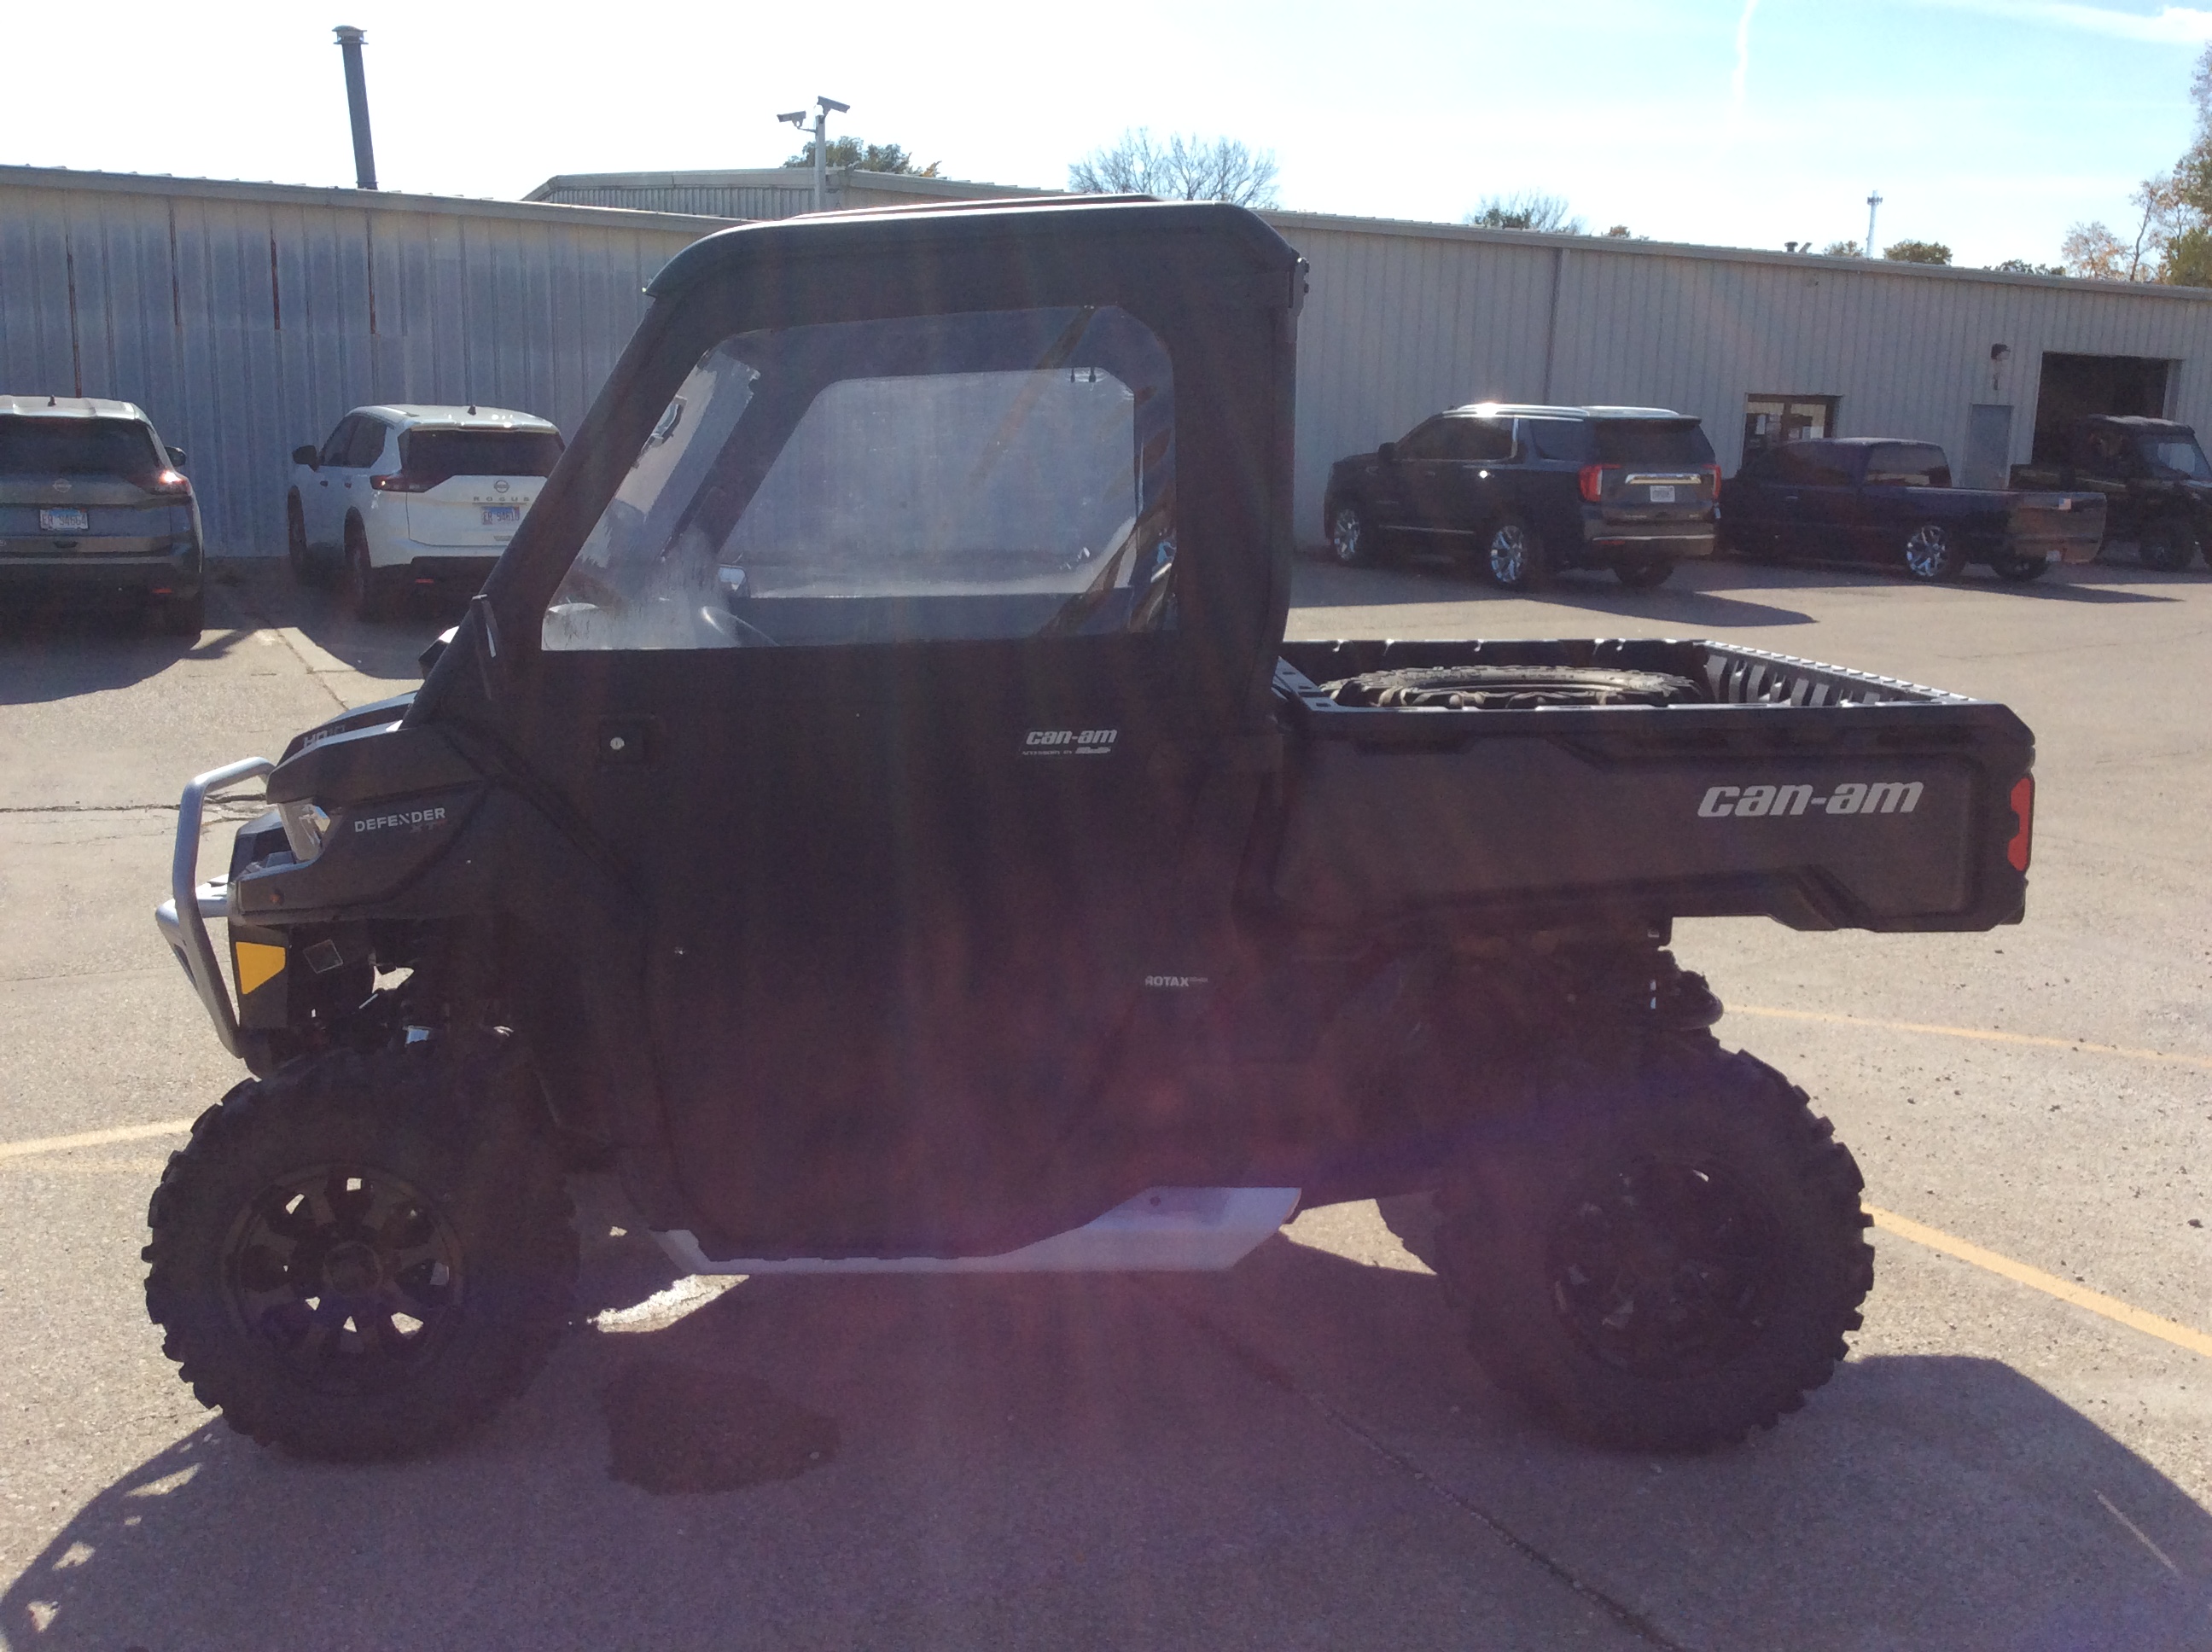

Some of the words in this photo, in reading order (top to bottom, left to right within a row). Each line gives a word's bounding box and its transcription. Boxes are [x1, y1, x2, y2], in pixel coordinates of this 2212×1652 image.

[1026, 729, 1118, 745] can-am
[1697, 781, 1924, 817] can-am
[354, 807, 445, 833] DEFENDER
[1144, 975, 1190, 987] ROTAX
